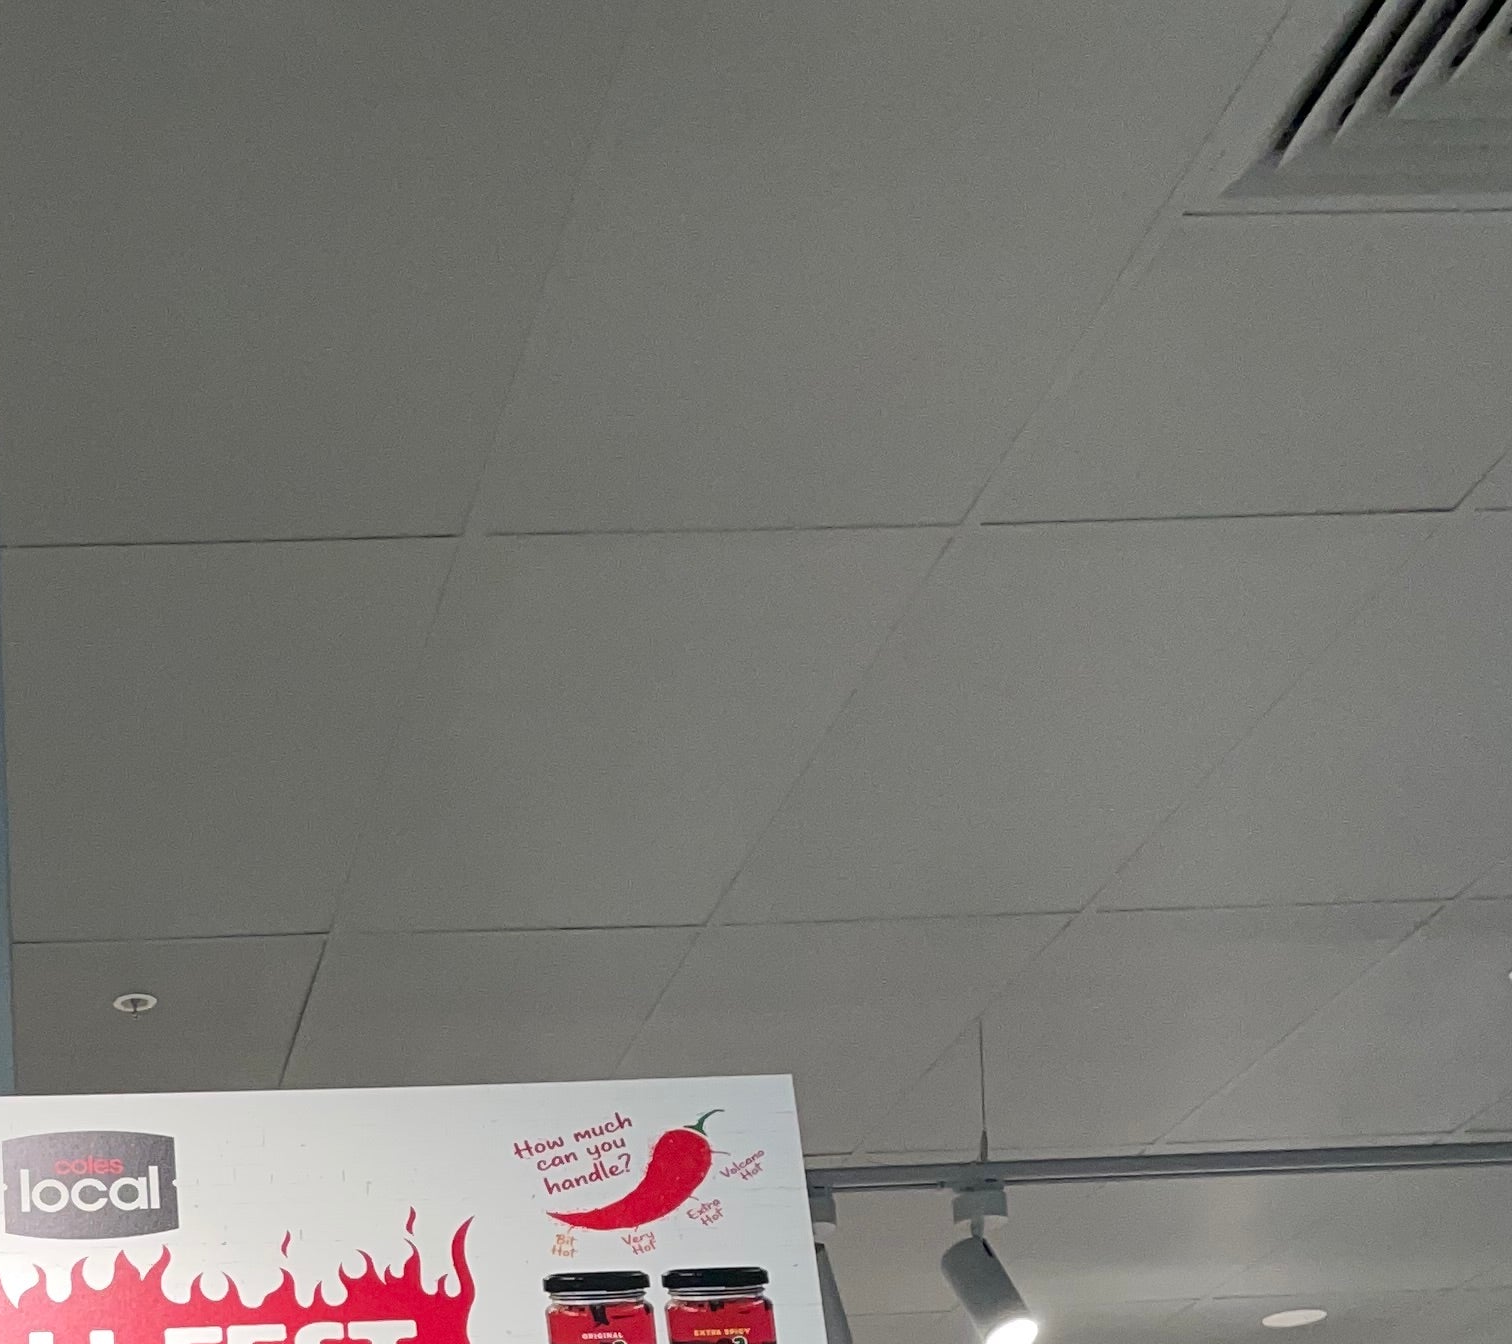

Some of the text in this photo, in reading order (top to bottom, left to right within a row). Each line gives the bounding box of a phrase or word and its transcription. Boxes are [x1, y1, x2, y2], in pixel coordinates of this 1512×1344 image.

[513, 1111, 633, 1160] How much
[54, 1154, 124, 1175] coles
[536, 1137, 626, 1172] can you
[719, 1149, 765, 1178] Volcano
[543, 1153, 632, 1196] handle?
[741, 1163, 764, 1181] Hot
[19, 1165, 161, 1213] local
[686, 1198, 721, 1221] Extra
[700, 1209, 724, 1227] Hot
[621, 1231, 655, 1248] Very
